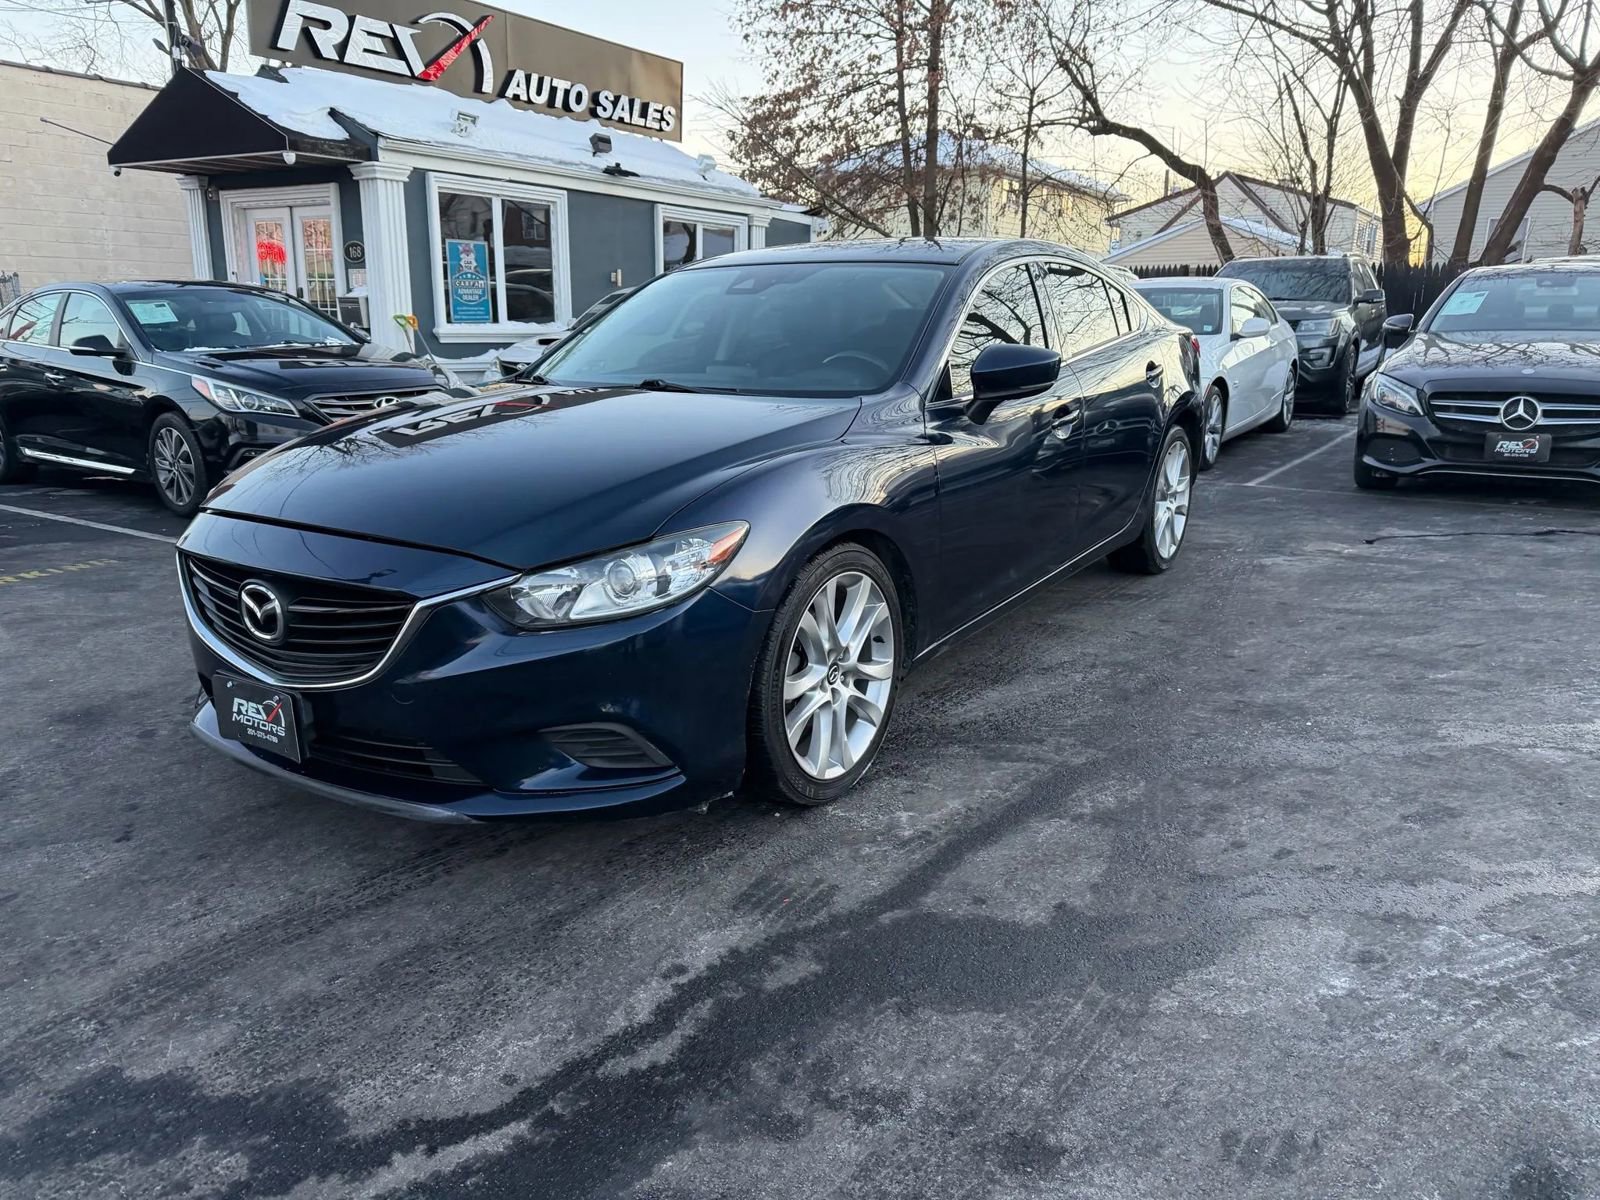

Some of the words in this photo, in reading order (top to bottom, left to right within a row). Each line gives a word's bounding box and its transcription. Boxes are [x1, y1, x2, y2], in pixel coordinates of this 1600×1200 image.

[505, 69, 589, 113] AUTO
[597, 90, 676, 132] SALES
[349, 246, 362, 258] 168
[232, 712, 286, 737] MOTORS
